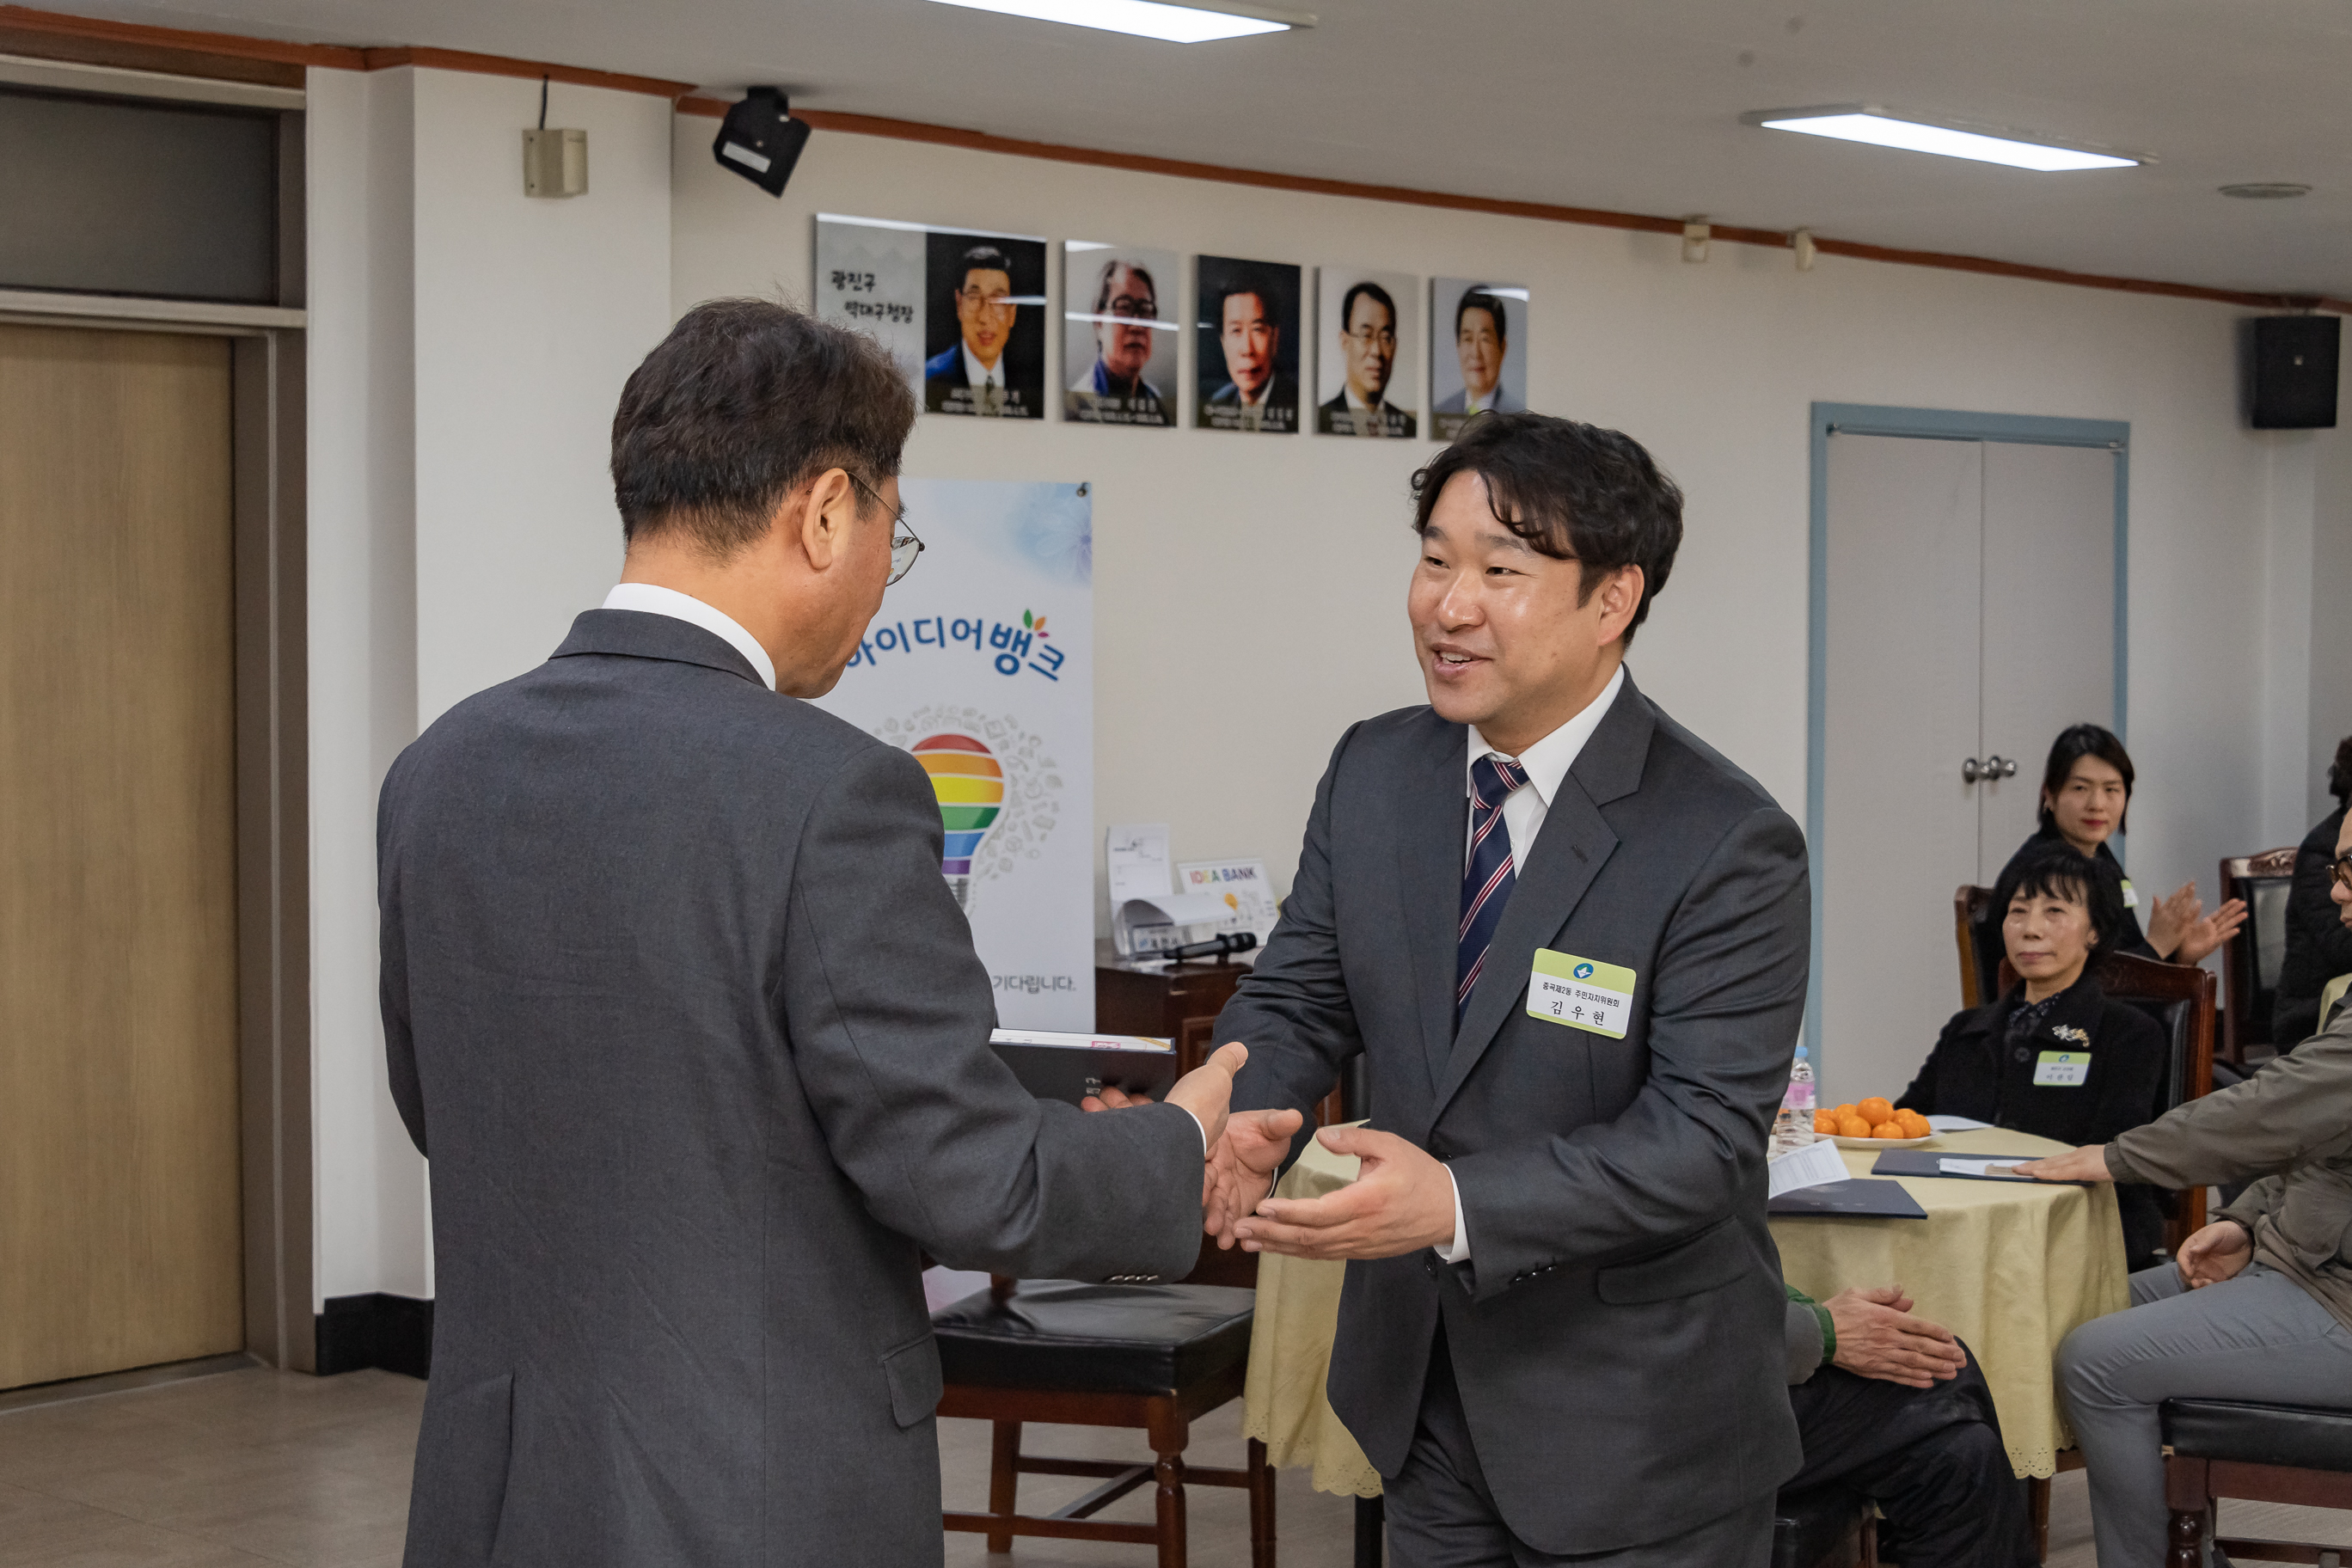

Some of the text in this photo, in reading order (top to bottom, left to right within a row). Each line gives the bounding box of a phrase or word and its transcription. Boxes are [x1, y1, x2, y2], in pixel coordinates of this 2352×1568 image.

[831, 270, 875, 292] 광진구
[1190, 867, 1258, 885] IDEA BANK
[1542, 981, 1620, 1008] 중곡제2동 주민자치위원회
